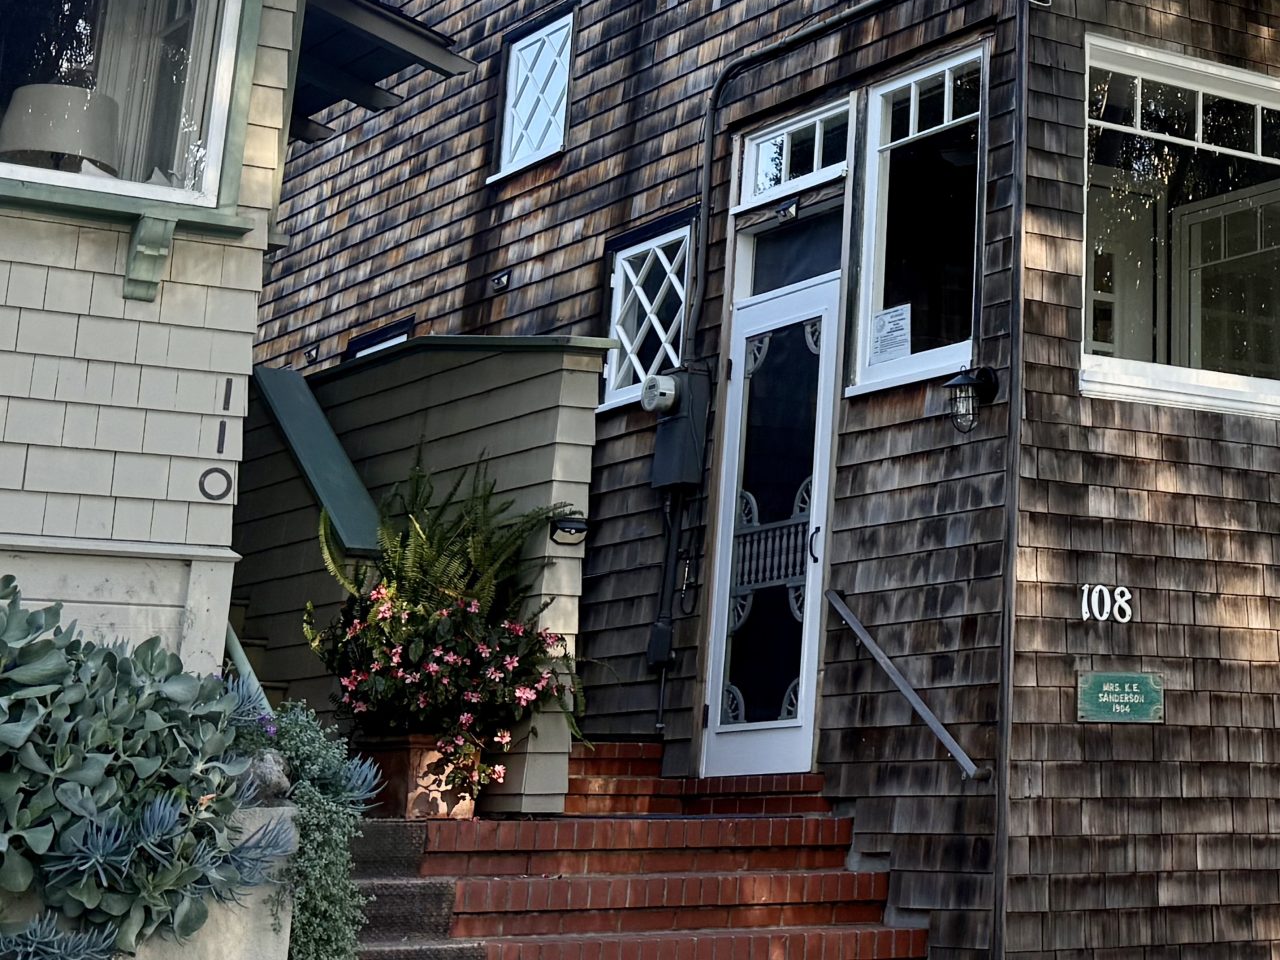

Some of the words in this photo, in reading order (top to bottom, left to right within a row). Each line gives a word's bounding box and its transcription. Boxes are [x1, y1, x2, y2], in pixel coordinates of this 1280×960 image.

[198, 377, 233, 501] 110
[1081, 584, 1132, 623] 108
[1098, 693, 1145, 703] SANDERSON
[1112, 703, 1131, 712] 1904
